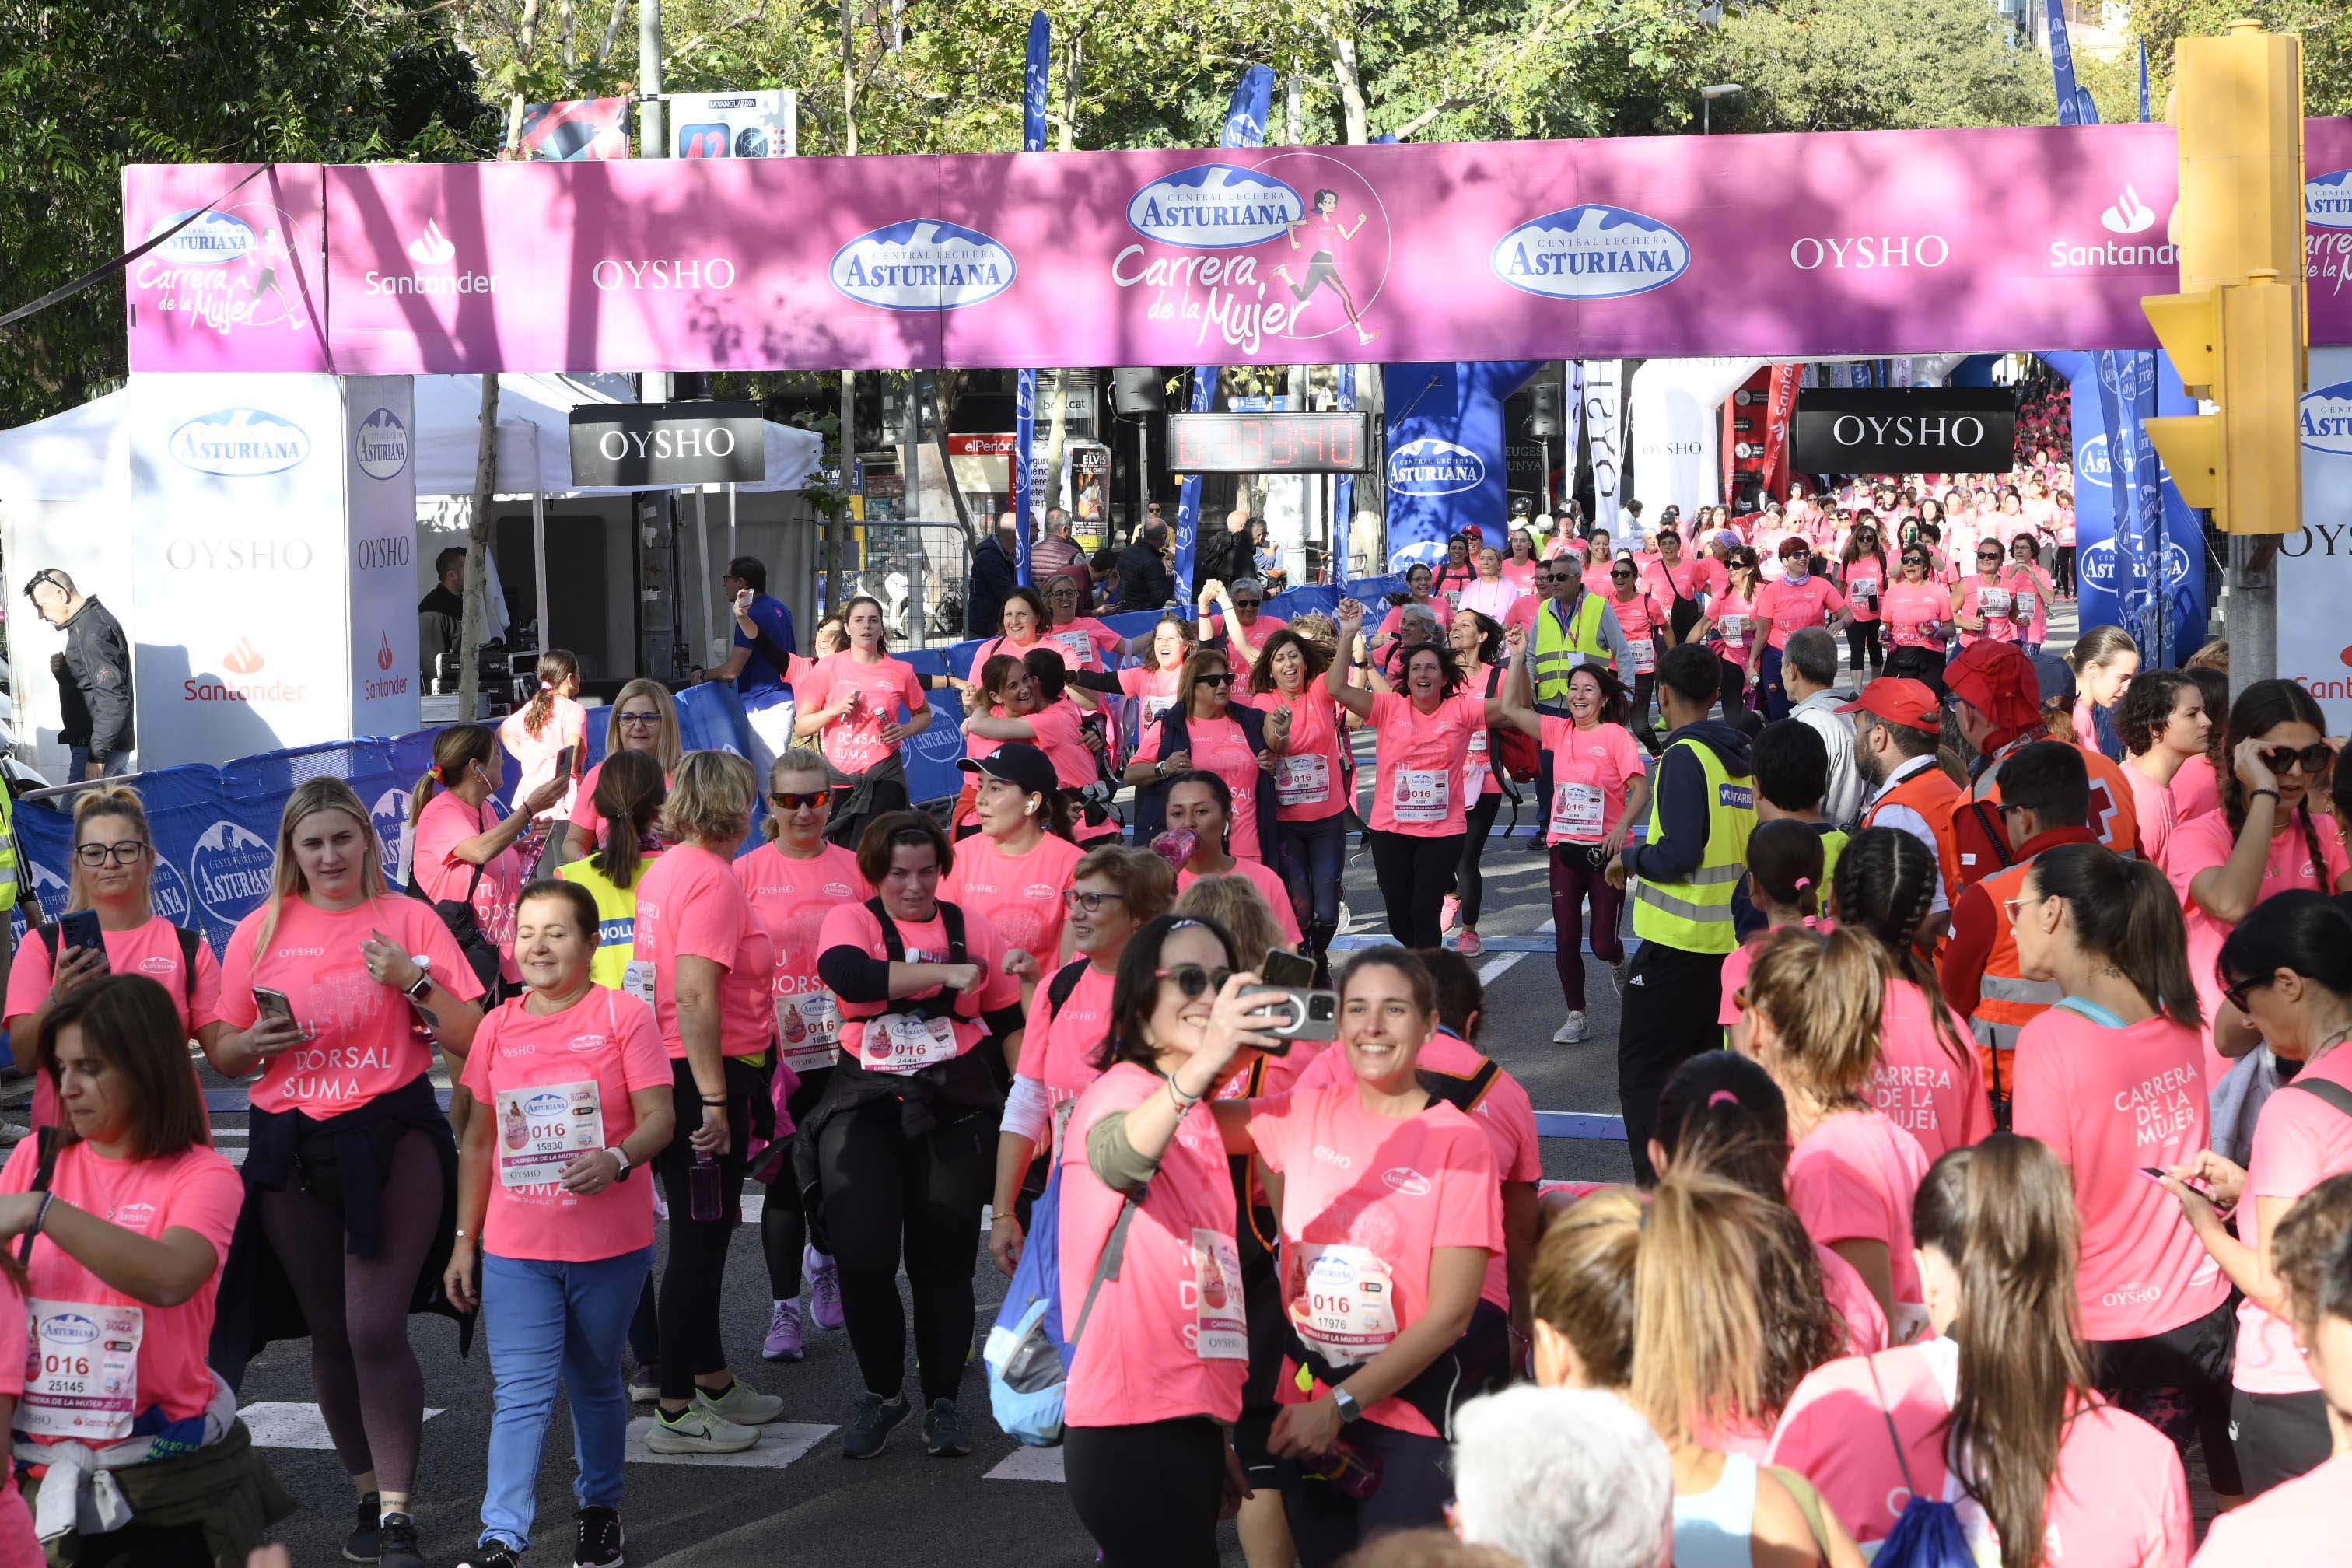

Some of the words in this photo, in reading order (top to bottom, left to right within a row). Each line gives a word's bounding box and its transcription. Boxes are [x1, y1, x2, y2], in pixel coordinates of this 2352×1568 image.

[1167, 192, 1224, 202] CENTRAL
[1228, 191, 1285, 201] LECHERA
[2305, 192, 2352, 214] STU
[1140, 196, 1291, 228] ASTURIANA
[1537, 238, 1599, 247] CENTRAL
[1605, 236, 1668, 246] LECHERA
[1790, 234, 1949, 269] OYSHO
[2305, 233, 2352, 255] arre
[873, 250, 932, 261] CENTRAL
[937, 249, 996, 260] LECHERA
[1507, 240, 1675, 276] ASTURIANA
[136, 261, 227, 290] Carrera
[592, 258, 735, 291] OYSHO
[845, 254, 1002, 287] ASTURIANA
[1111, 244, 1255, 288] Carrera
[2323, 256, 2336, 277] la
[365, 271, 499, 296] Santander
[158, 291, 176, 311] de
[179, 292, 192, 311] la
[189, 289, 261, 334] Mujer
[1147, 290, 1174, 320] de
[1181, 289, 1199, 320] la
[1196, 282, 1313, 355] Mujer
[1043, 398, 1086, 411] b.cat
[1587, 360, 1616, 498] OYSH
[1833, 415, 1983, 447] OYSHO
[180, 432, 300, 460] ASTURIANA
[360, 435, 405, 463] ASTURIANA
[600, 427, 735, 460] OYSHO
[964, 439, 1017, 452] elPeriódi
[1506, 446, 1543, 457] EUGES
[1643, 442, 1702, 456] OYSHO
[1082, 455, 1107, 464] ELVIS
[1507, 460, 1542, 471] UNYA
[1390, 463, 1478, 483] ASTURIANA
[166, 538, 313, 570] OYSHO
[358, 535, 410, 571] OYSHO
[184, 679, 305, 702] Santander
[365, 675, 408, 701] Santander
[834, 747, 869, 760] SUMA
[200, 864, 274, 905] ASTURIAN
[758, 885, 795, 894] OYSHO
[479, 902, 516, 921] DORS
[599, 924, 635, 940] VOLU
[278, 947, 324, 957] OYSHO
[772, 975, 829, 995] ORS
[808, 1020, 835, 1034] 016
[294, 1047, 392, 1071] DORSAL
[895, 1045, 926, 1056] 016
[282, 1076, 362, 1100] SUMA
[2114, 1062, 2198, 1112] CARRERA
[527, 1102, 566, 1114] ASTURIANA
[1877, 1089, 1902, 1108] DE
[1910, 1090, 1933, 1108] LA
[2136, 1104, 2161, 1126] DE
[2168, 1090, 2190, 1115] LA
[1888, 1109, 1938, 1130] UJER
[2136, 1108, 2195, 1147] MUJER
[532, 1123, 565, 1139] 016
[536, 1141, 563, 1151] 15830
[511, 1156, 538, 1165] CARRERA
[558, 1152, 579, 1160] MUJER
[510, 1170, 541, 1180] OYSHO
[1314, 1293, 1350, 1313] 016
[2102, 1286, 2161, 1307] OYSHO
[44, 1324, 94, 1338] ASTURIANA
[1318, 1318, 1346, 1329] 17976
[1339, 1334, 1365, 1344] MUJER
[44, 1355, 89, 1375] 016
[48, 1380, 84, 1393] 25145
[51, 1397, 62, 1406] DE
[64, 1398, 74, 1407] LA
[75, 1398, 102, 1409] MUJER
